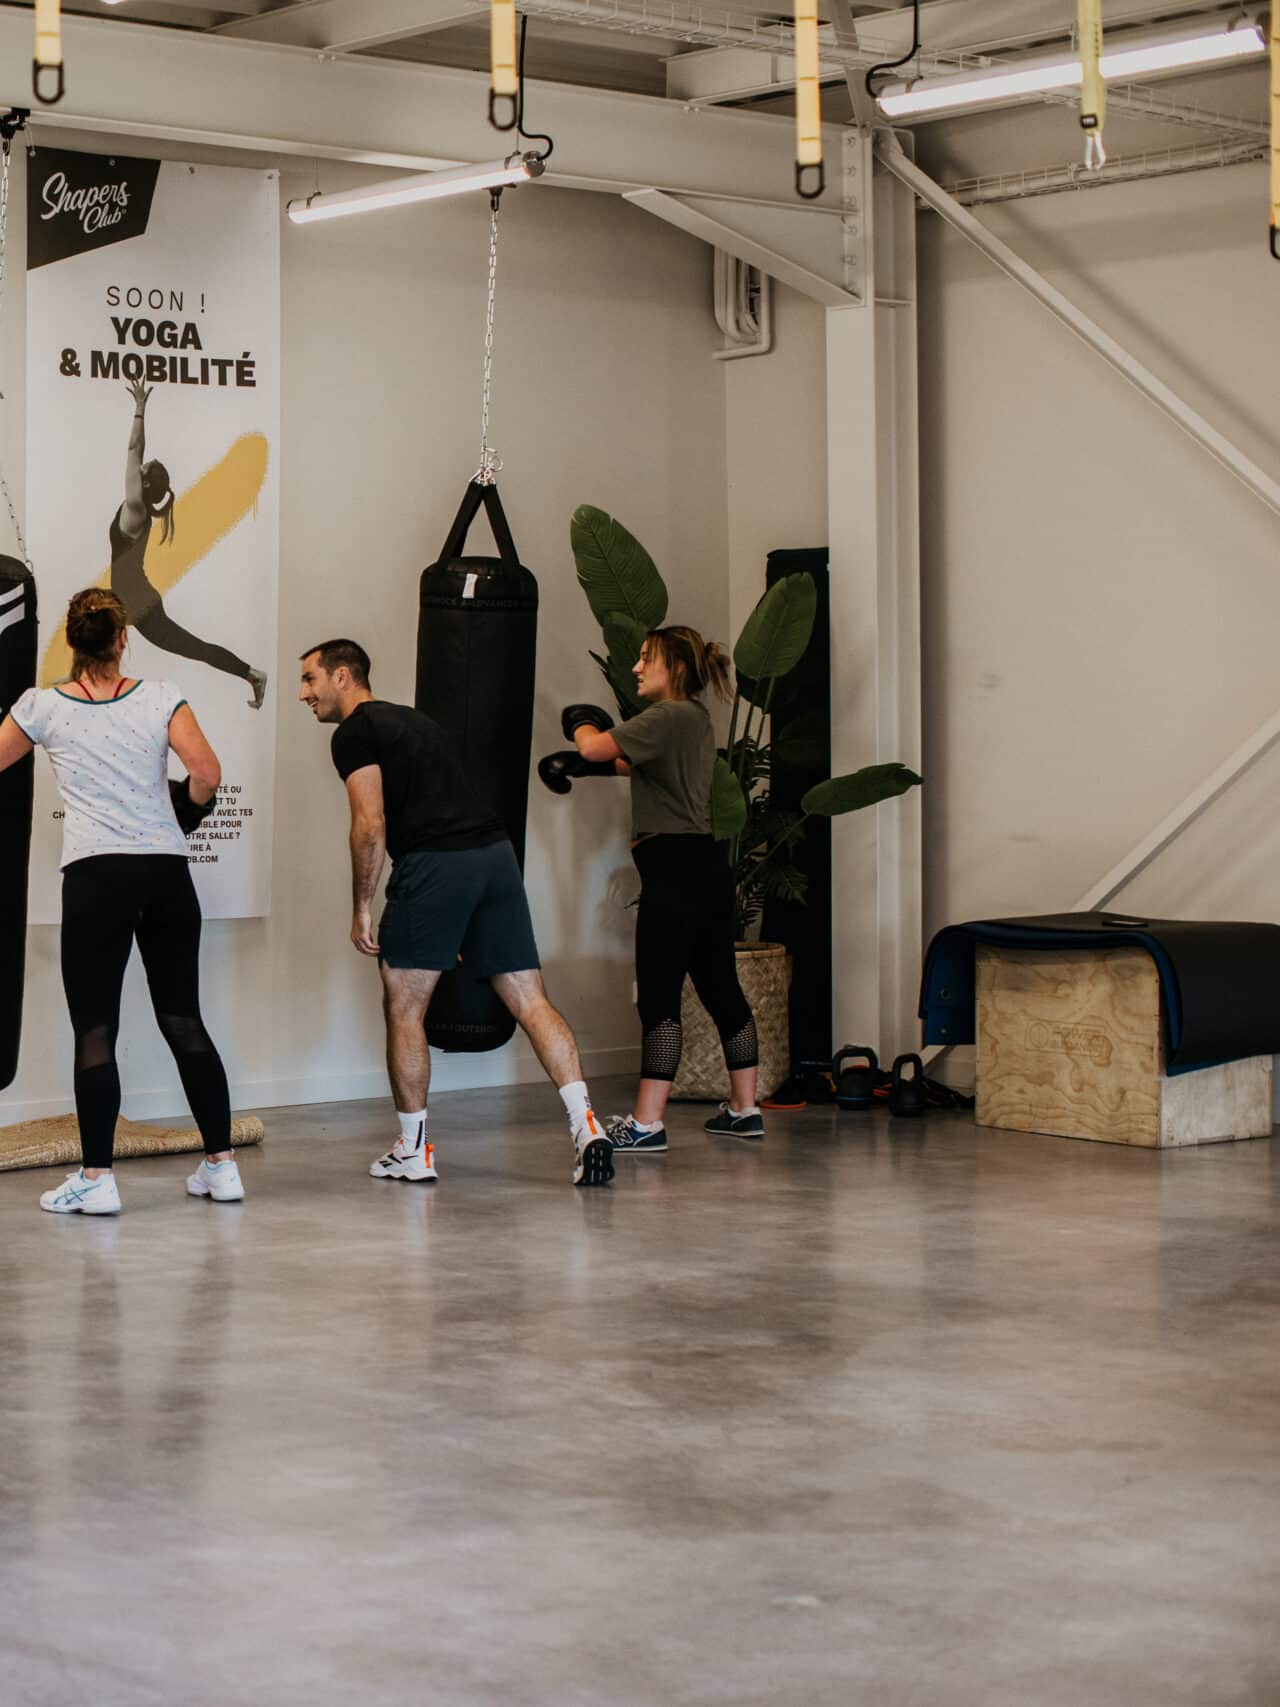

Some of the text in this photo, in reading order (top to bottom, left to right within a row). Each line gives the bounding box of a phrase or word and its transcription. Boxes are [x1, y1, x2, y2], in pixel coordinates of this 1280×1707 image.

[40, 172, 132, 220] Shapers
[84, 203, 121, 233] Club
[107, 286, 183, 311] SOON
[111, 317, 202, 350] YOGA
[60, 348, 256, 387] & MOBILITÉ
